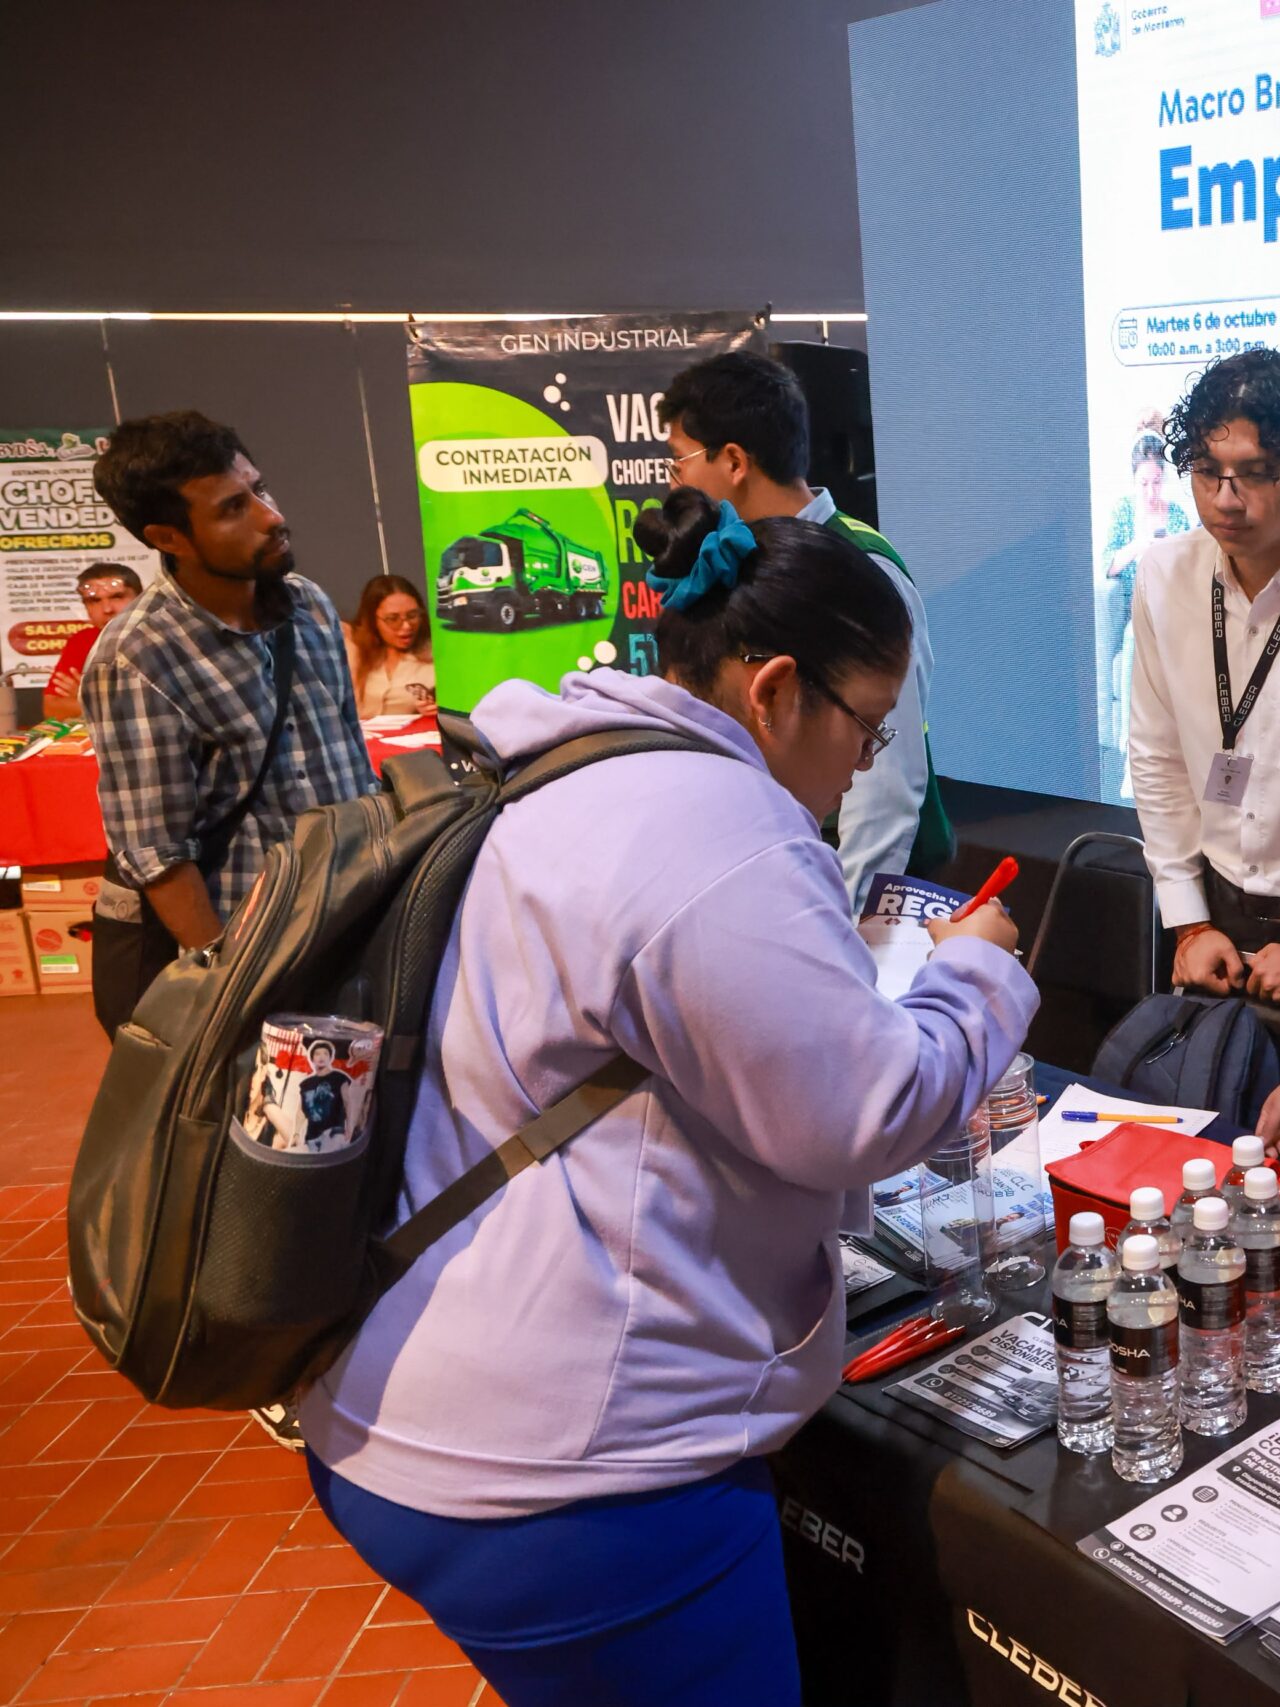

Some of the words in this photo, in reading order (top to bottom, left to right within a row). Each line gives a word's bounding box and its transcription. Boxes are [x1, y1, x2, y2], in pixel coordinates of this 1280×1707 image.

[1158, 88, 1245, 127] Macro
[1147, 317, 1190, 334] Martes
[1193, 313, 1202, 331] 6
[1205, 312, 1220, 329] de
[1224, 309, 1277, 328] octubre
[501, 333, 550, 354] GEN
[556, 329, 697, 352] INDUSTRIAL
[1147, 342, 1175, 357] 10:00
[1179, 343, 1202, 355] a.m.
[1215, 338, 1240, 353] 3:00
[436, 442, 592, 466] CONTRATACIÓN
[463, 467, 572, 485] INMEDIATA
[0, 533, 111, 549] OFRECEMOS
[1213, 588, 1223, 638] CLEBER
[1218, 673, 1231, 722] CLEBER
[1233, 684, 1258, 727] CLEBER
[884, 883, 946, 902] Aprovecha
[949, 898, 960, 907] la
[989, 1336, 1056, 1371] DISPONIBLES
[1242, 1458, 1257, 1470] DE
[1241, 1472, 1280, 1498] Disponibilidad
[1108, 1557, 1143, 1582] CONTACTO
[1146, 1580, 1183, 1608] WHATSAPP:
